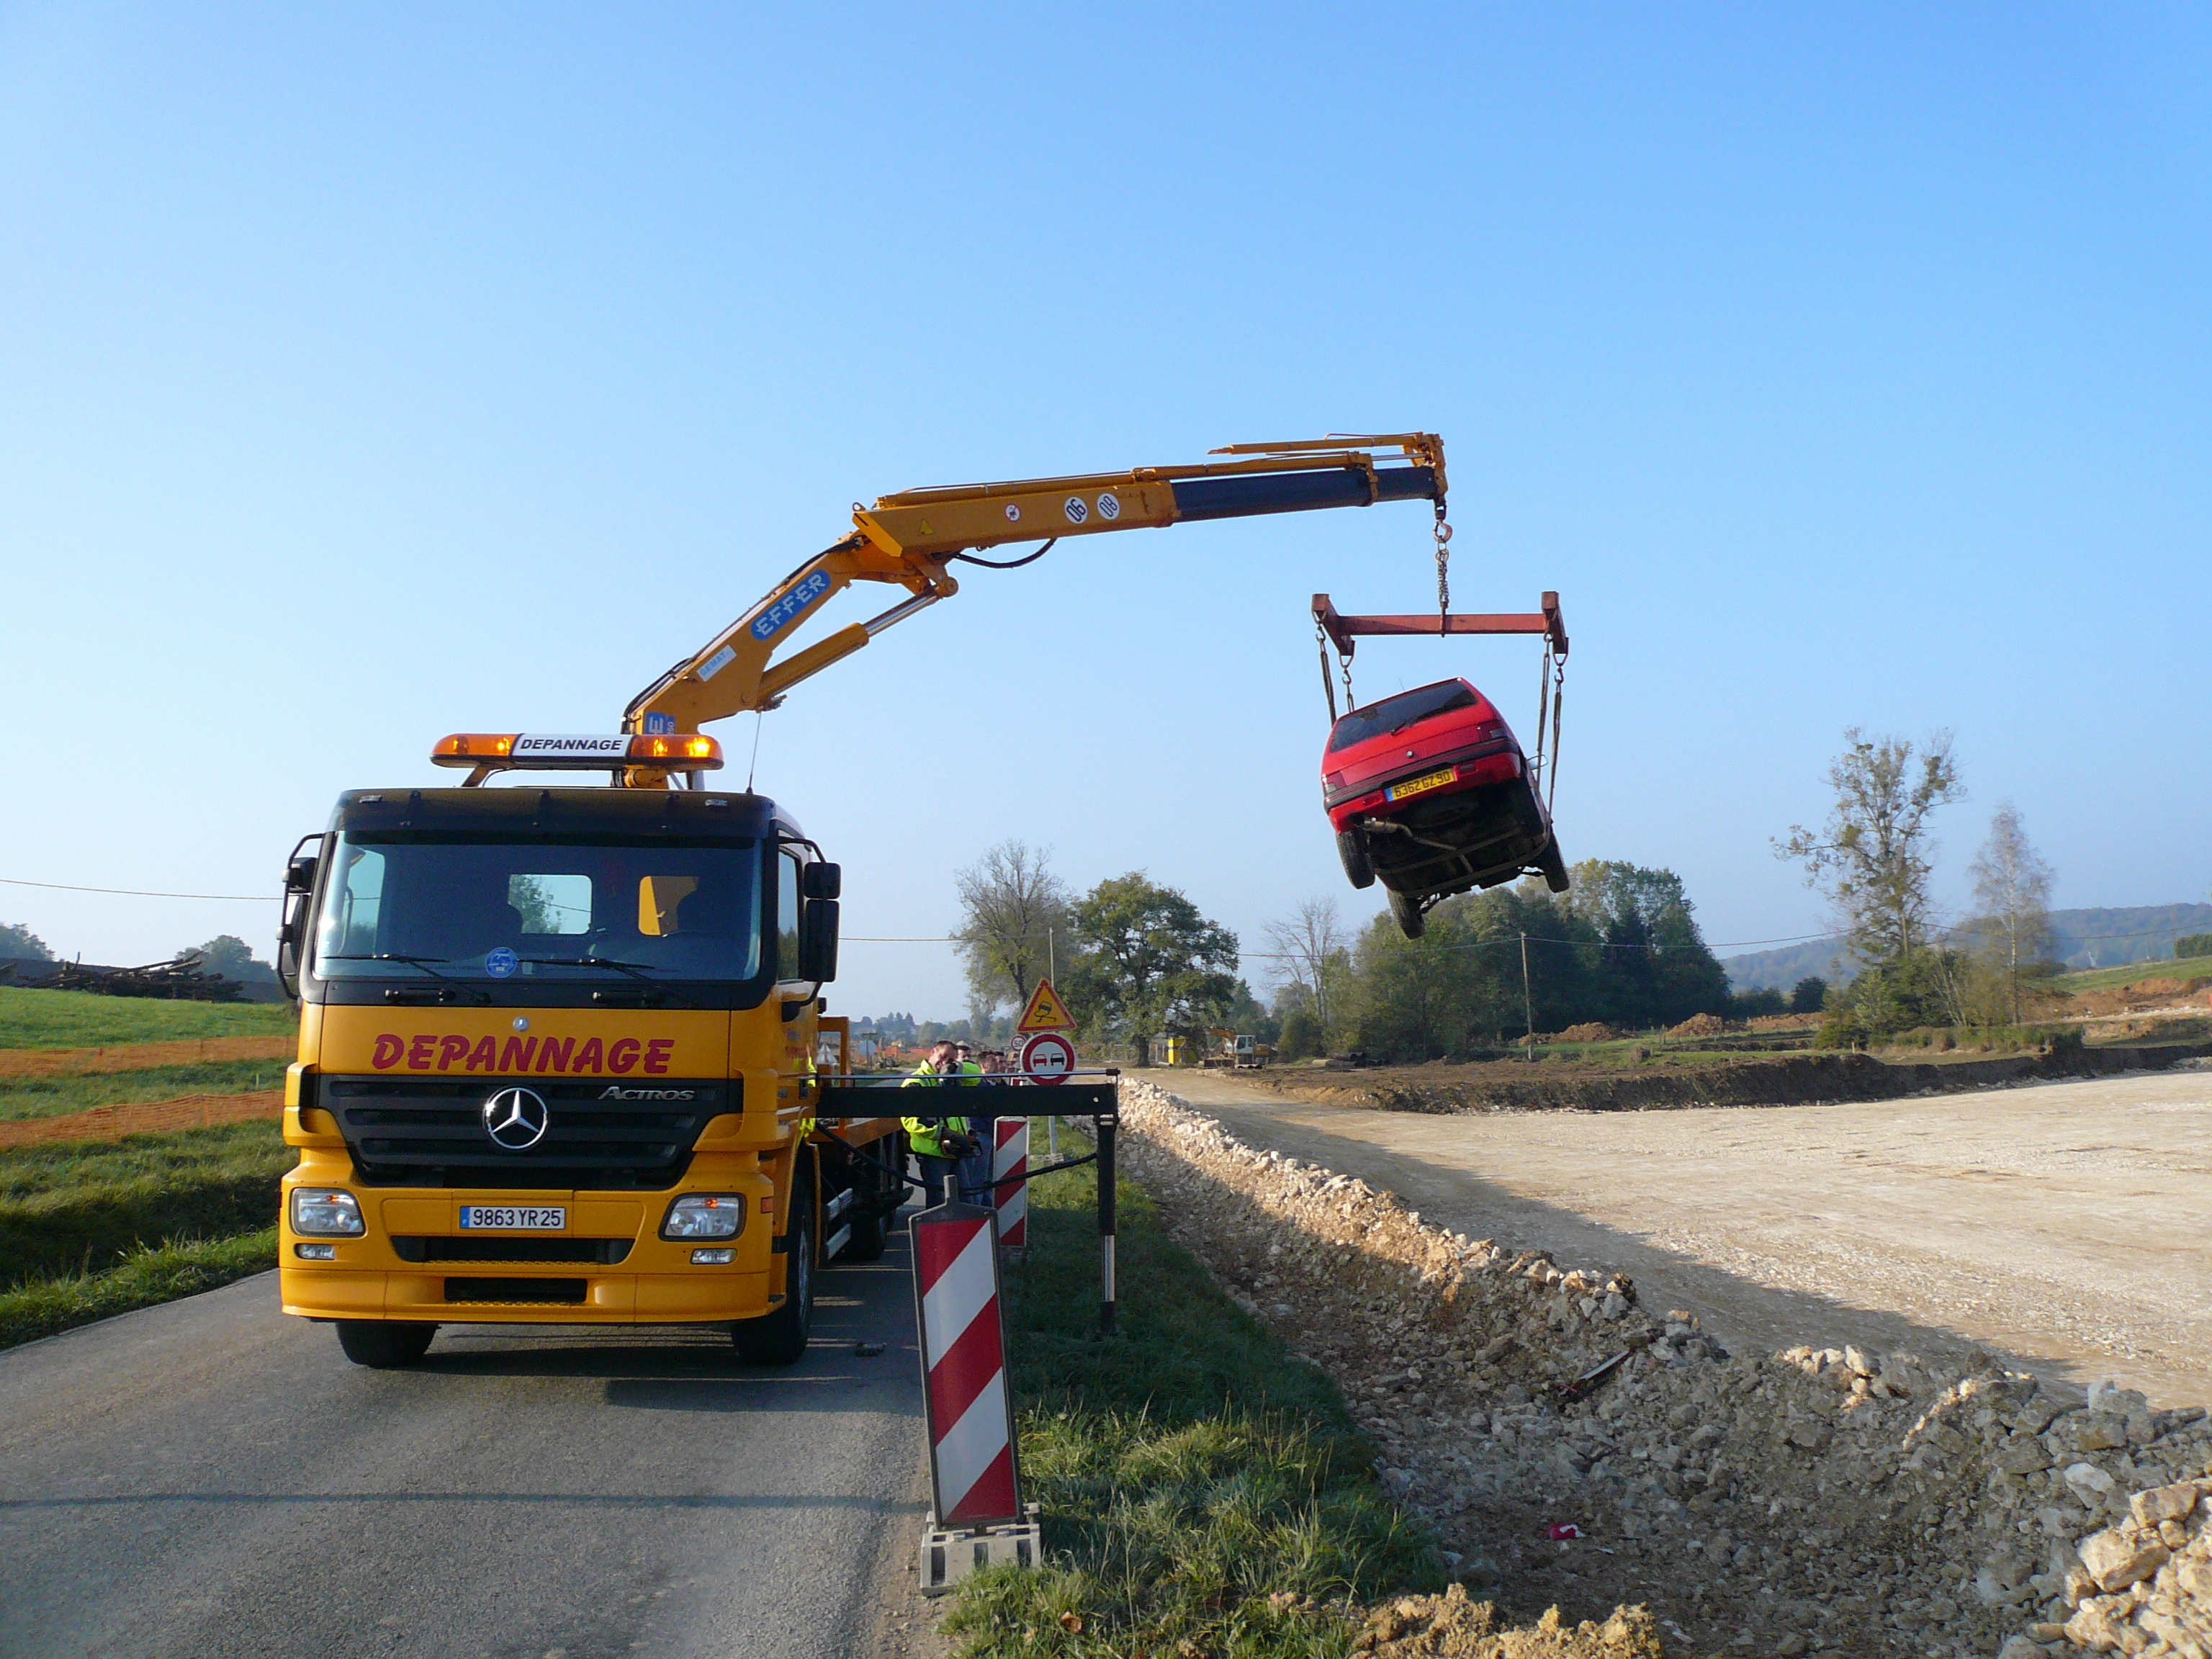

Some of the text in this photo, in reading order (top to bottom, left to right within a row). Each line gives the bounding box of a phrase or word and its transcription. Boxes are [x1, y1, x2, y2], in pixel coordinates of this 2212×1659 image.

[1066, 498, 1087, 522] 06
[1100, 495, 1118, 518] 08
[755, 574, 826, 635] EFFER
[520, 739, 623, 750] DEPANNAGE
[1393, 771, 1451, 798] 6362 GZ 90
[372, 1033, 675, 1074] DEPANNAGE
[473, 1209, 561, 1226] 9863 YR 25
